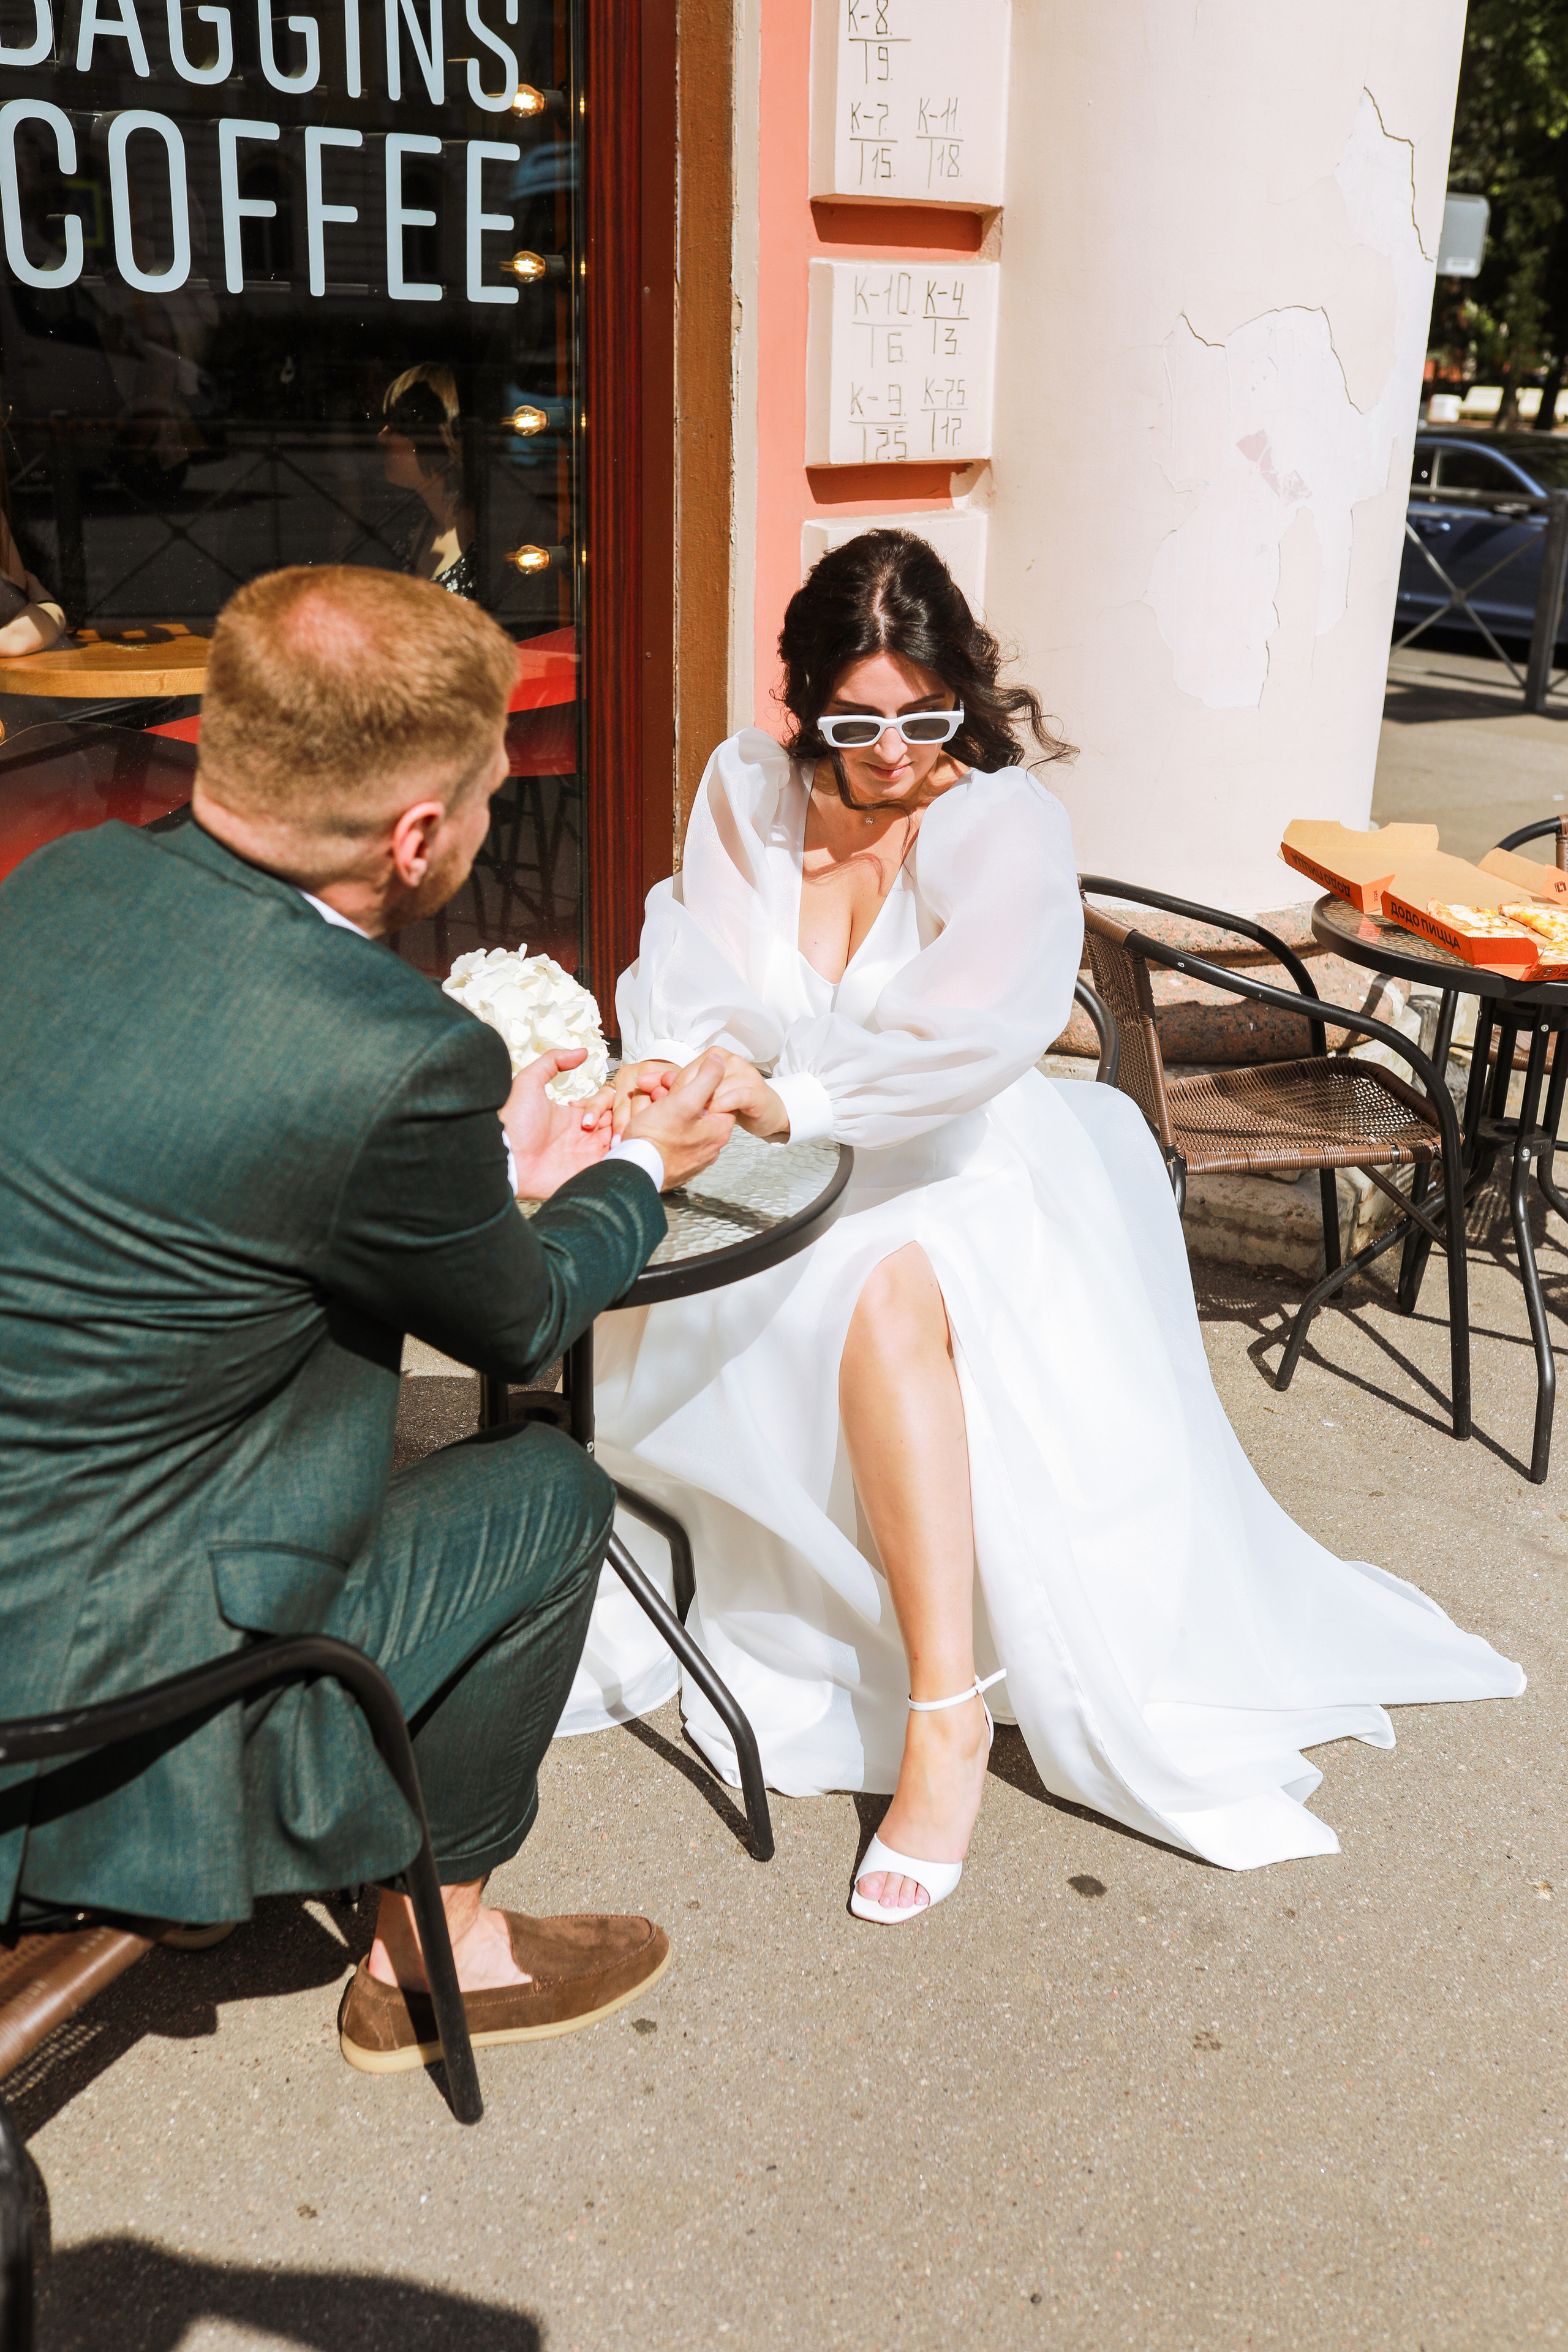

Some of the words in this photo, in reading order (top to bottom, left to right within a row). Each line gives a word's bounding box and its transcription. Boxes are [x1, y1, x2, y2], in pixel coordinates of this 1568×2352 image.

[0, 99, 520, 304] COFFEE
[1291, 852, 1324, 881] ПИЦЦА
[1324, 874, 1351, 897] ДОДО
[1391, 901, 1420, 927] ДОДО
[1421, 918, 1461, 950] ПИЦЦА
